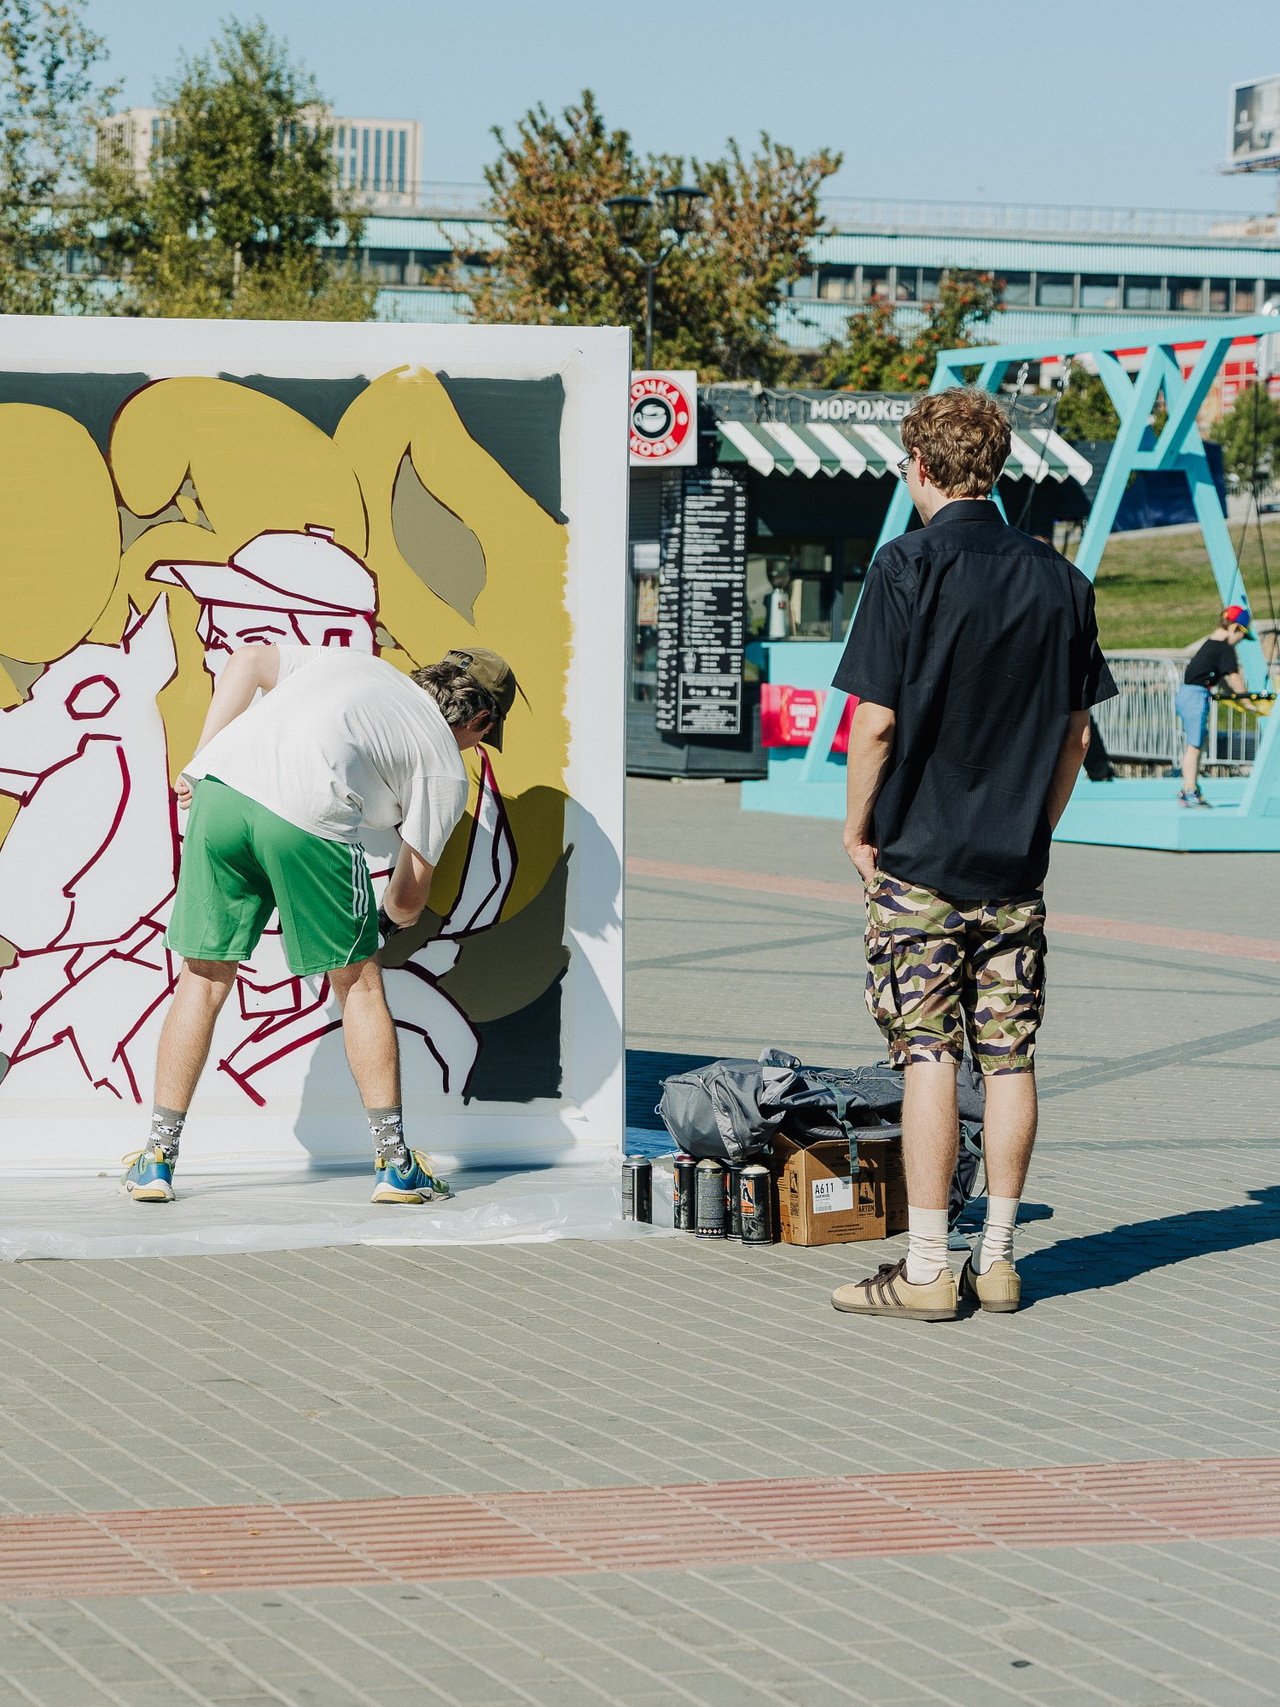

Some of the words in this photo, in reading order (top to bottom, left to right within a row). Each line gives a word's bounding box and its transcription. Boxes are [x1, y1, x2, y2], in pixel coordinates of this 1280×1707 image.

[631, 380, 680, 406] ОЧКА
[630, 435, 678, 456] КОФЕ
[815, 1183, 834, 1195] A611
[858, 1205, 875, 1213] ARTON
